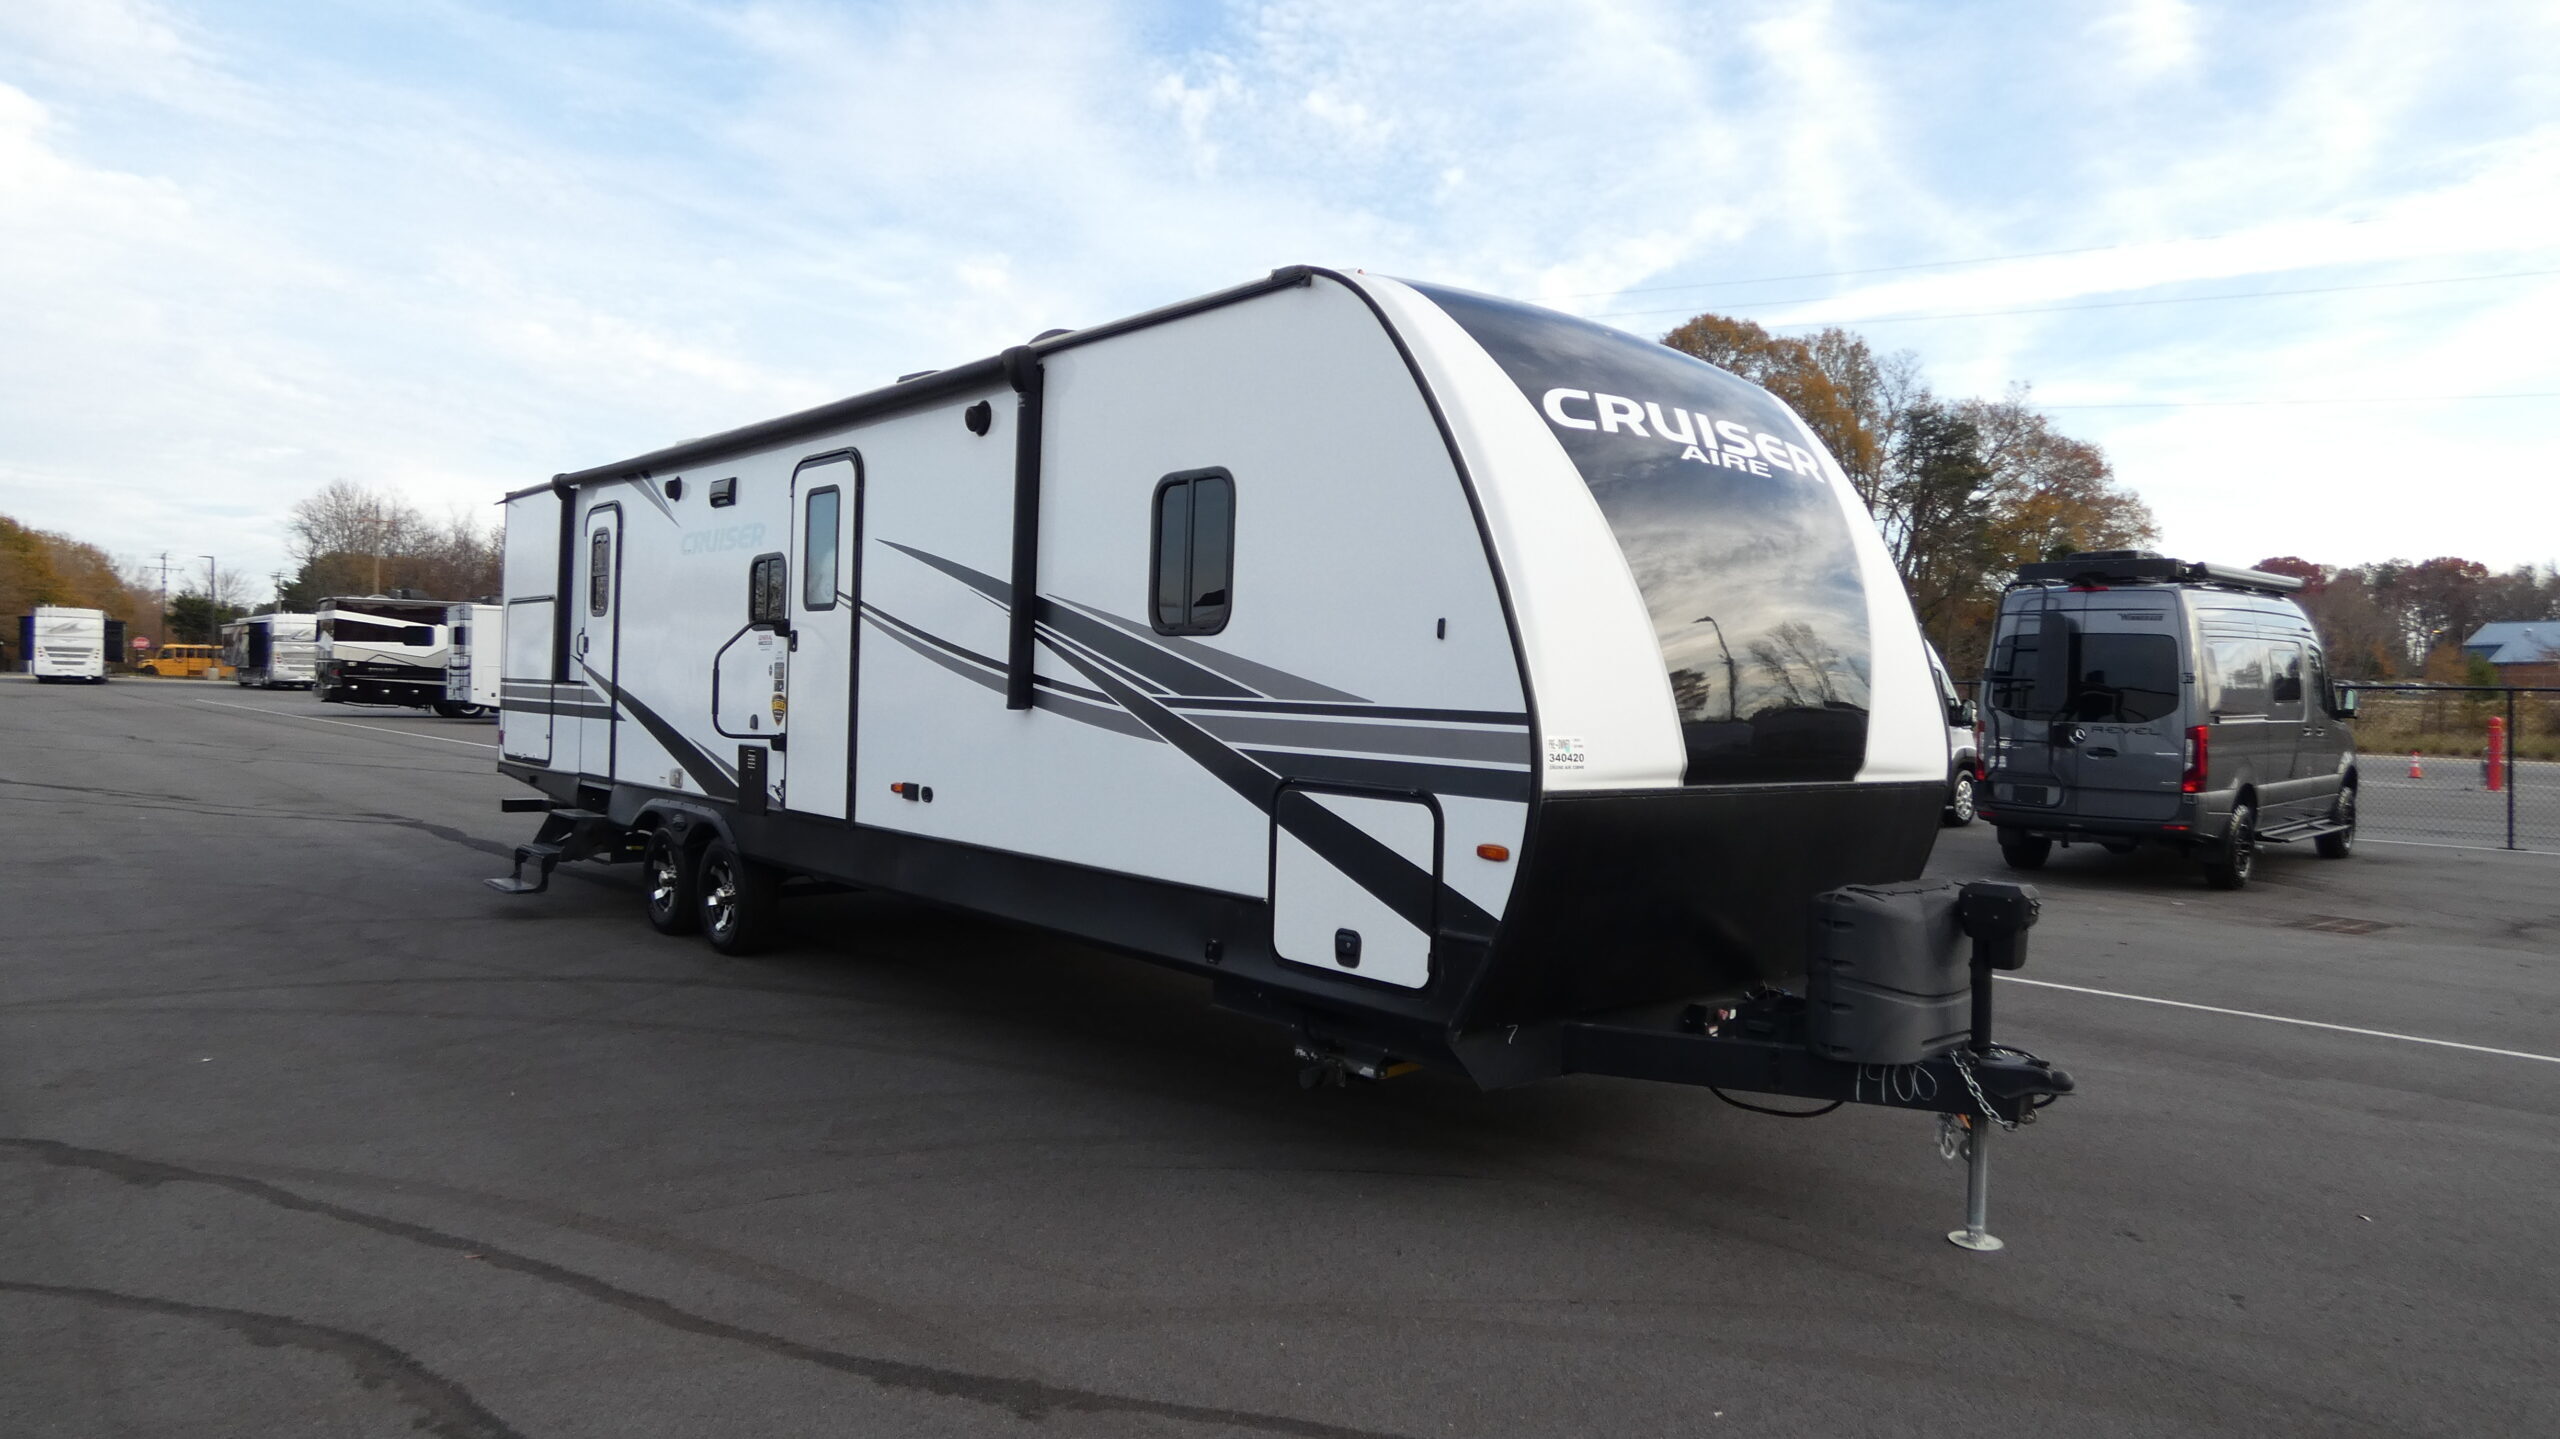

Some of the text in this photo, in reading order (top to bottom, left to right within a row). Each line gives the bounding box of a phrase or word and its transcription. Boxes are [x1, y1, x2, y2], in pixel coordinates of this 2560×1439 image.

[1542, 387, 1826, 484] CRUISER
[1680, 445, 1773, 479] AIRE
[681, 522, 767, 556] CRUISER
[2091, 725, 2162, 736] REVEL
[1549, 753, 1585, 763] 340420
